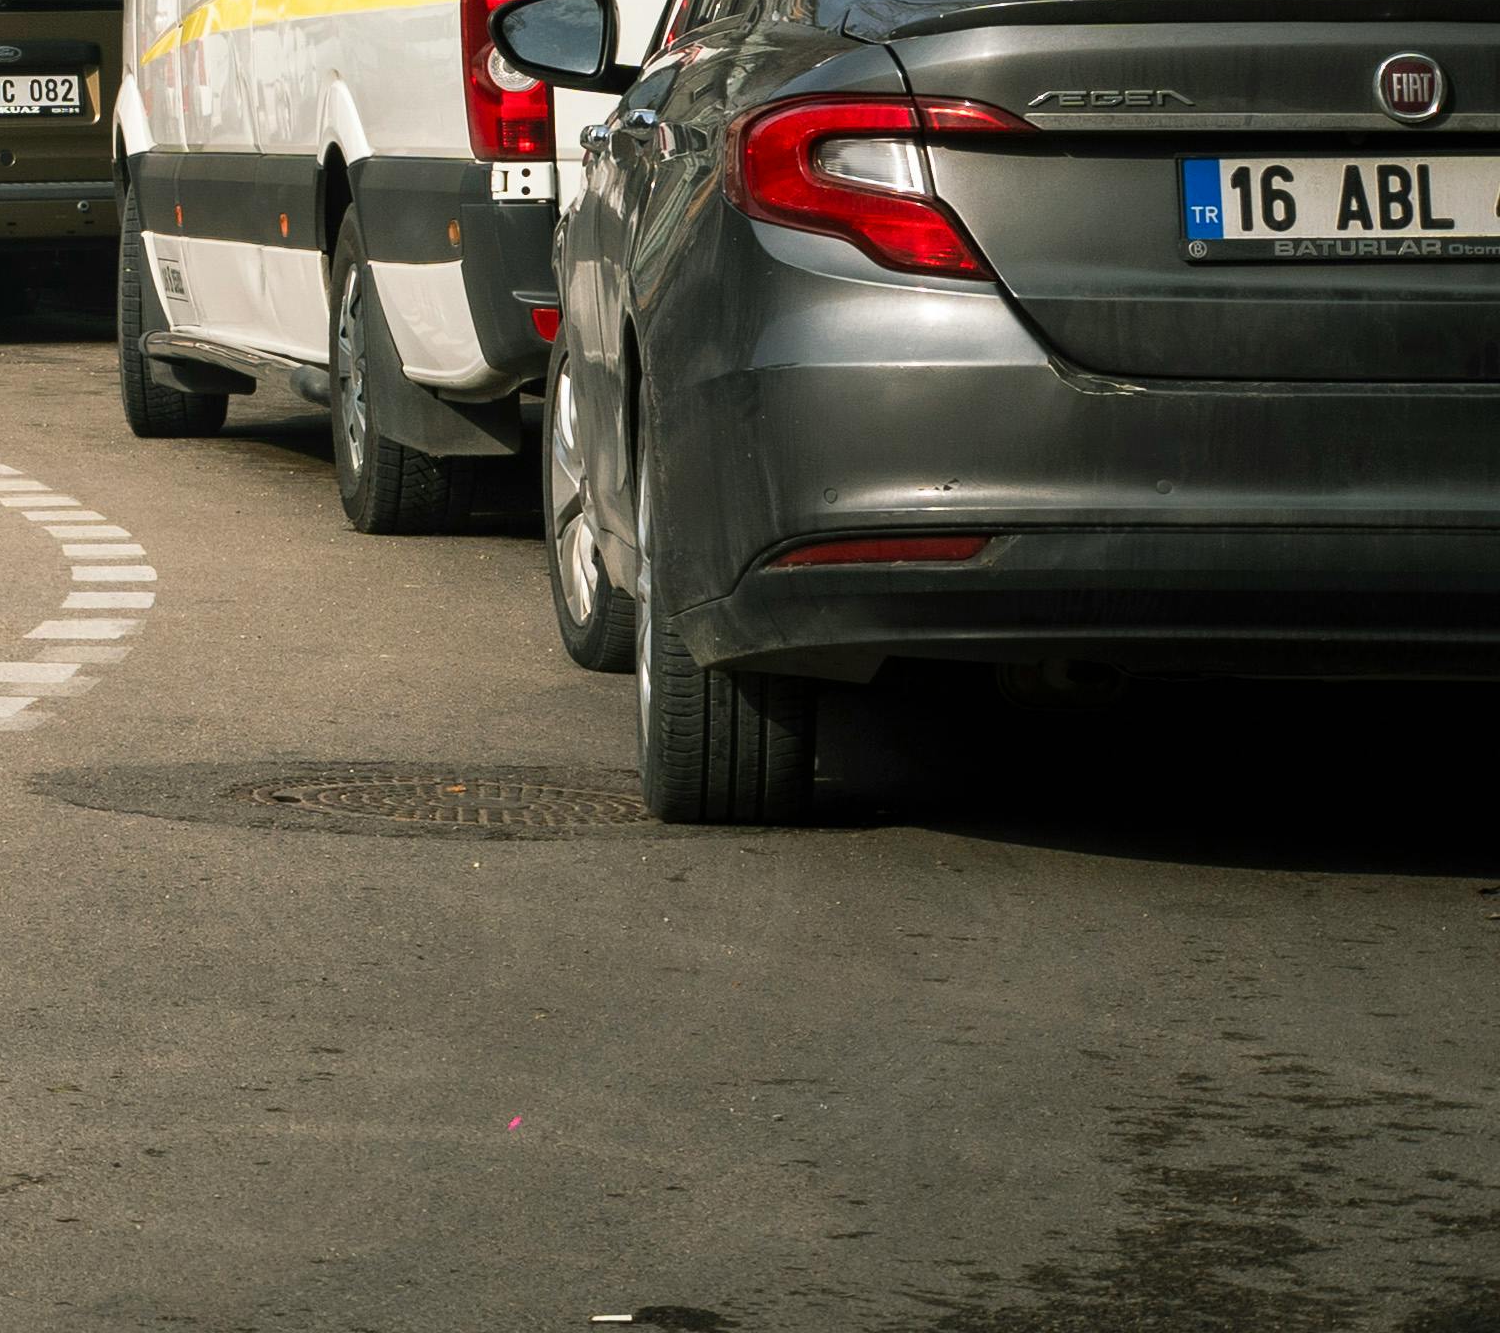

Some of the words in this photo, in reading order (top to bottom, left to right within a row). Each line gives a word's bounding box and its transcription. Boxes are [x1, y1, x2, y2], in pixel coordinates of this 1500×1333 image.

[29, 79, 75, 102] 082
[1392, 73, 1432, 104] FIAT
[1190, 205, 1219, 224] TR
[1230, 165, 1297, 232] 16
[1336, 164, 1455, 231] ABL
[1274, 239, 1442, 257] BATURLAR
